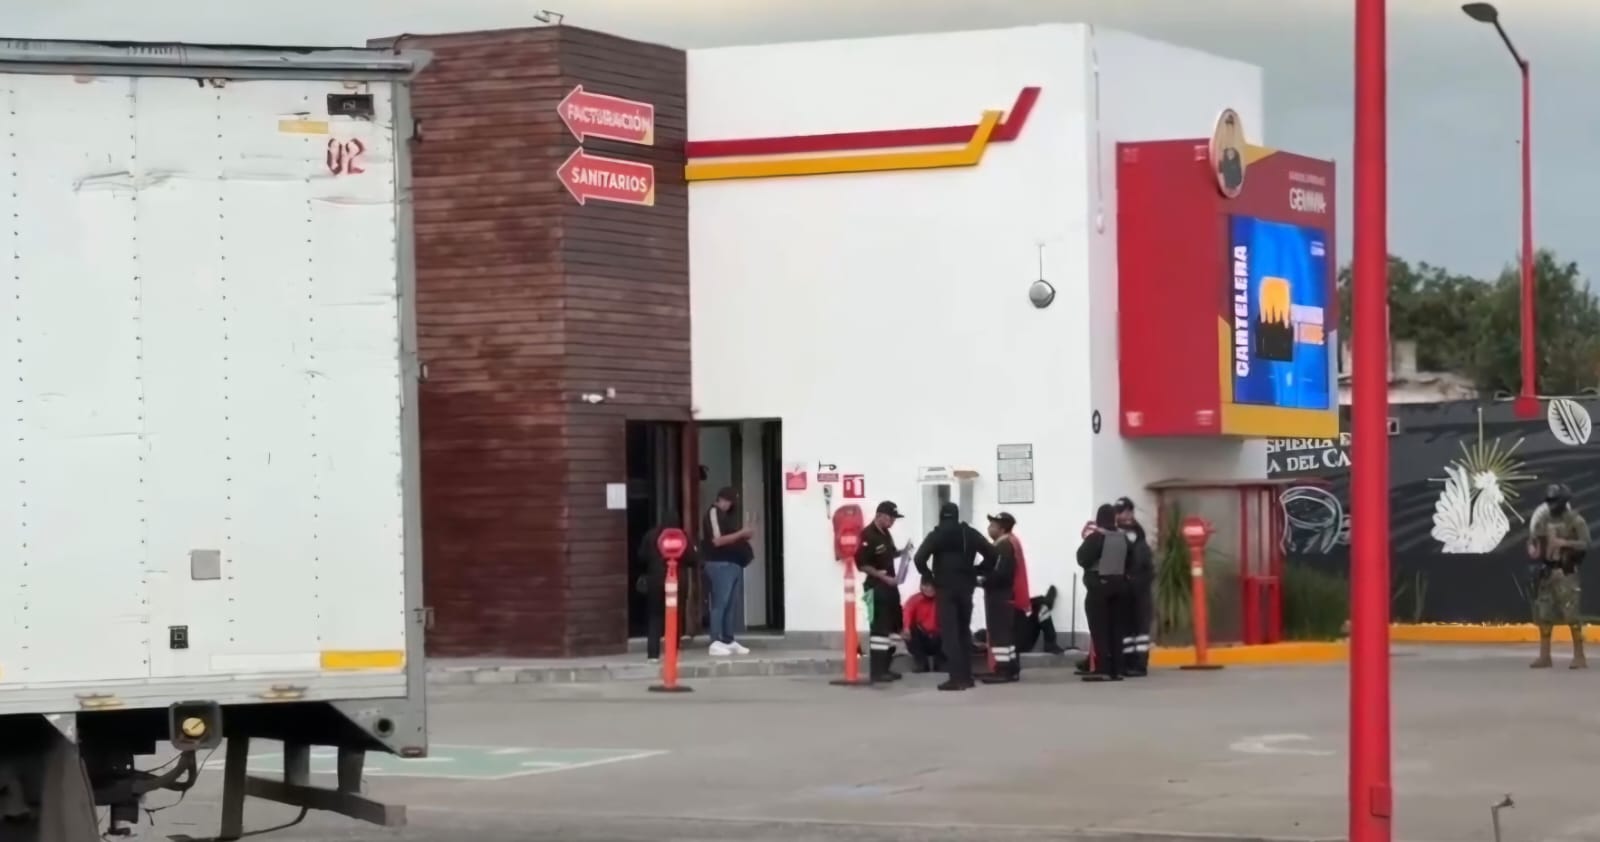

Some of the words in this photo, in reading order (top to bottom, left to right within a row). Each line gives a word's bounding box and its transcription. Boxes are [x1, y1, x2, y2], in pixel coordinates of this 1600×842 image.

[567, 103, 651, 133] FACTURACIÓN
[326, 137, 366, 175] 02
[571, 166, 648, 192] SANITARIOS
[1234, 246, 1249, 377] CARTELERA
[1286, 455, 1320, 472] DEL
